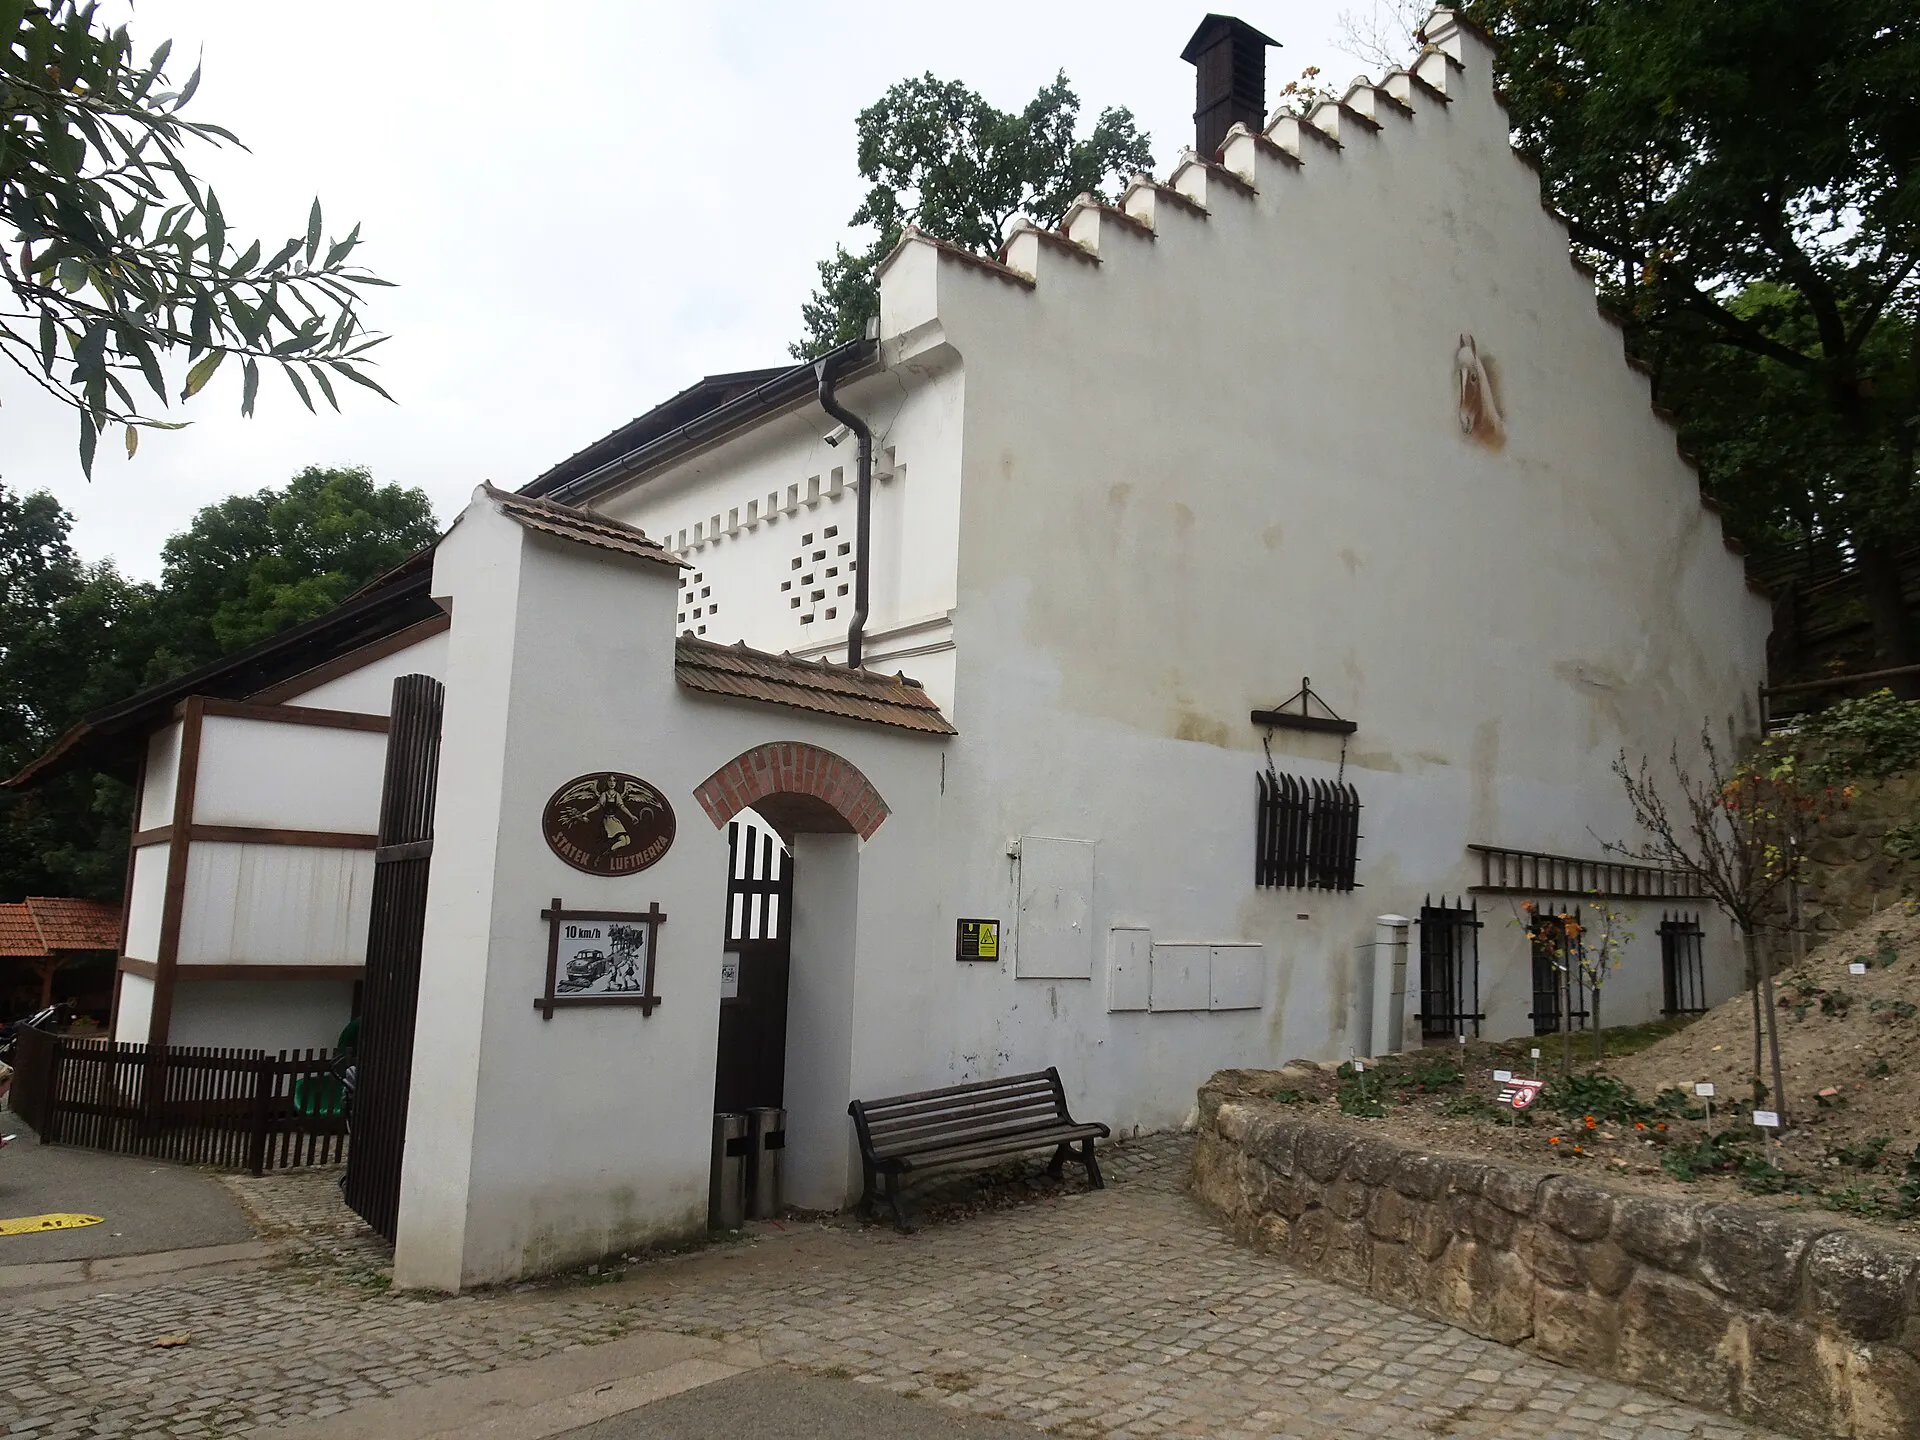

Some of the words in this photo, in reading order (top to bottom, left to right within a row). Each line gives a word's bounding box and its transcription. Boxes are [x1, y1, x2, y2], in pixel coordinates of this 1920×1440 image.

[552, 831, 590, 866] STATEK
[565, 926, 577, 939] 10
[579, 928, 601, 939] km/h
